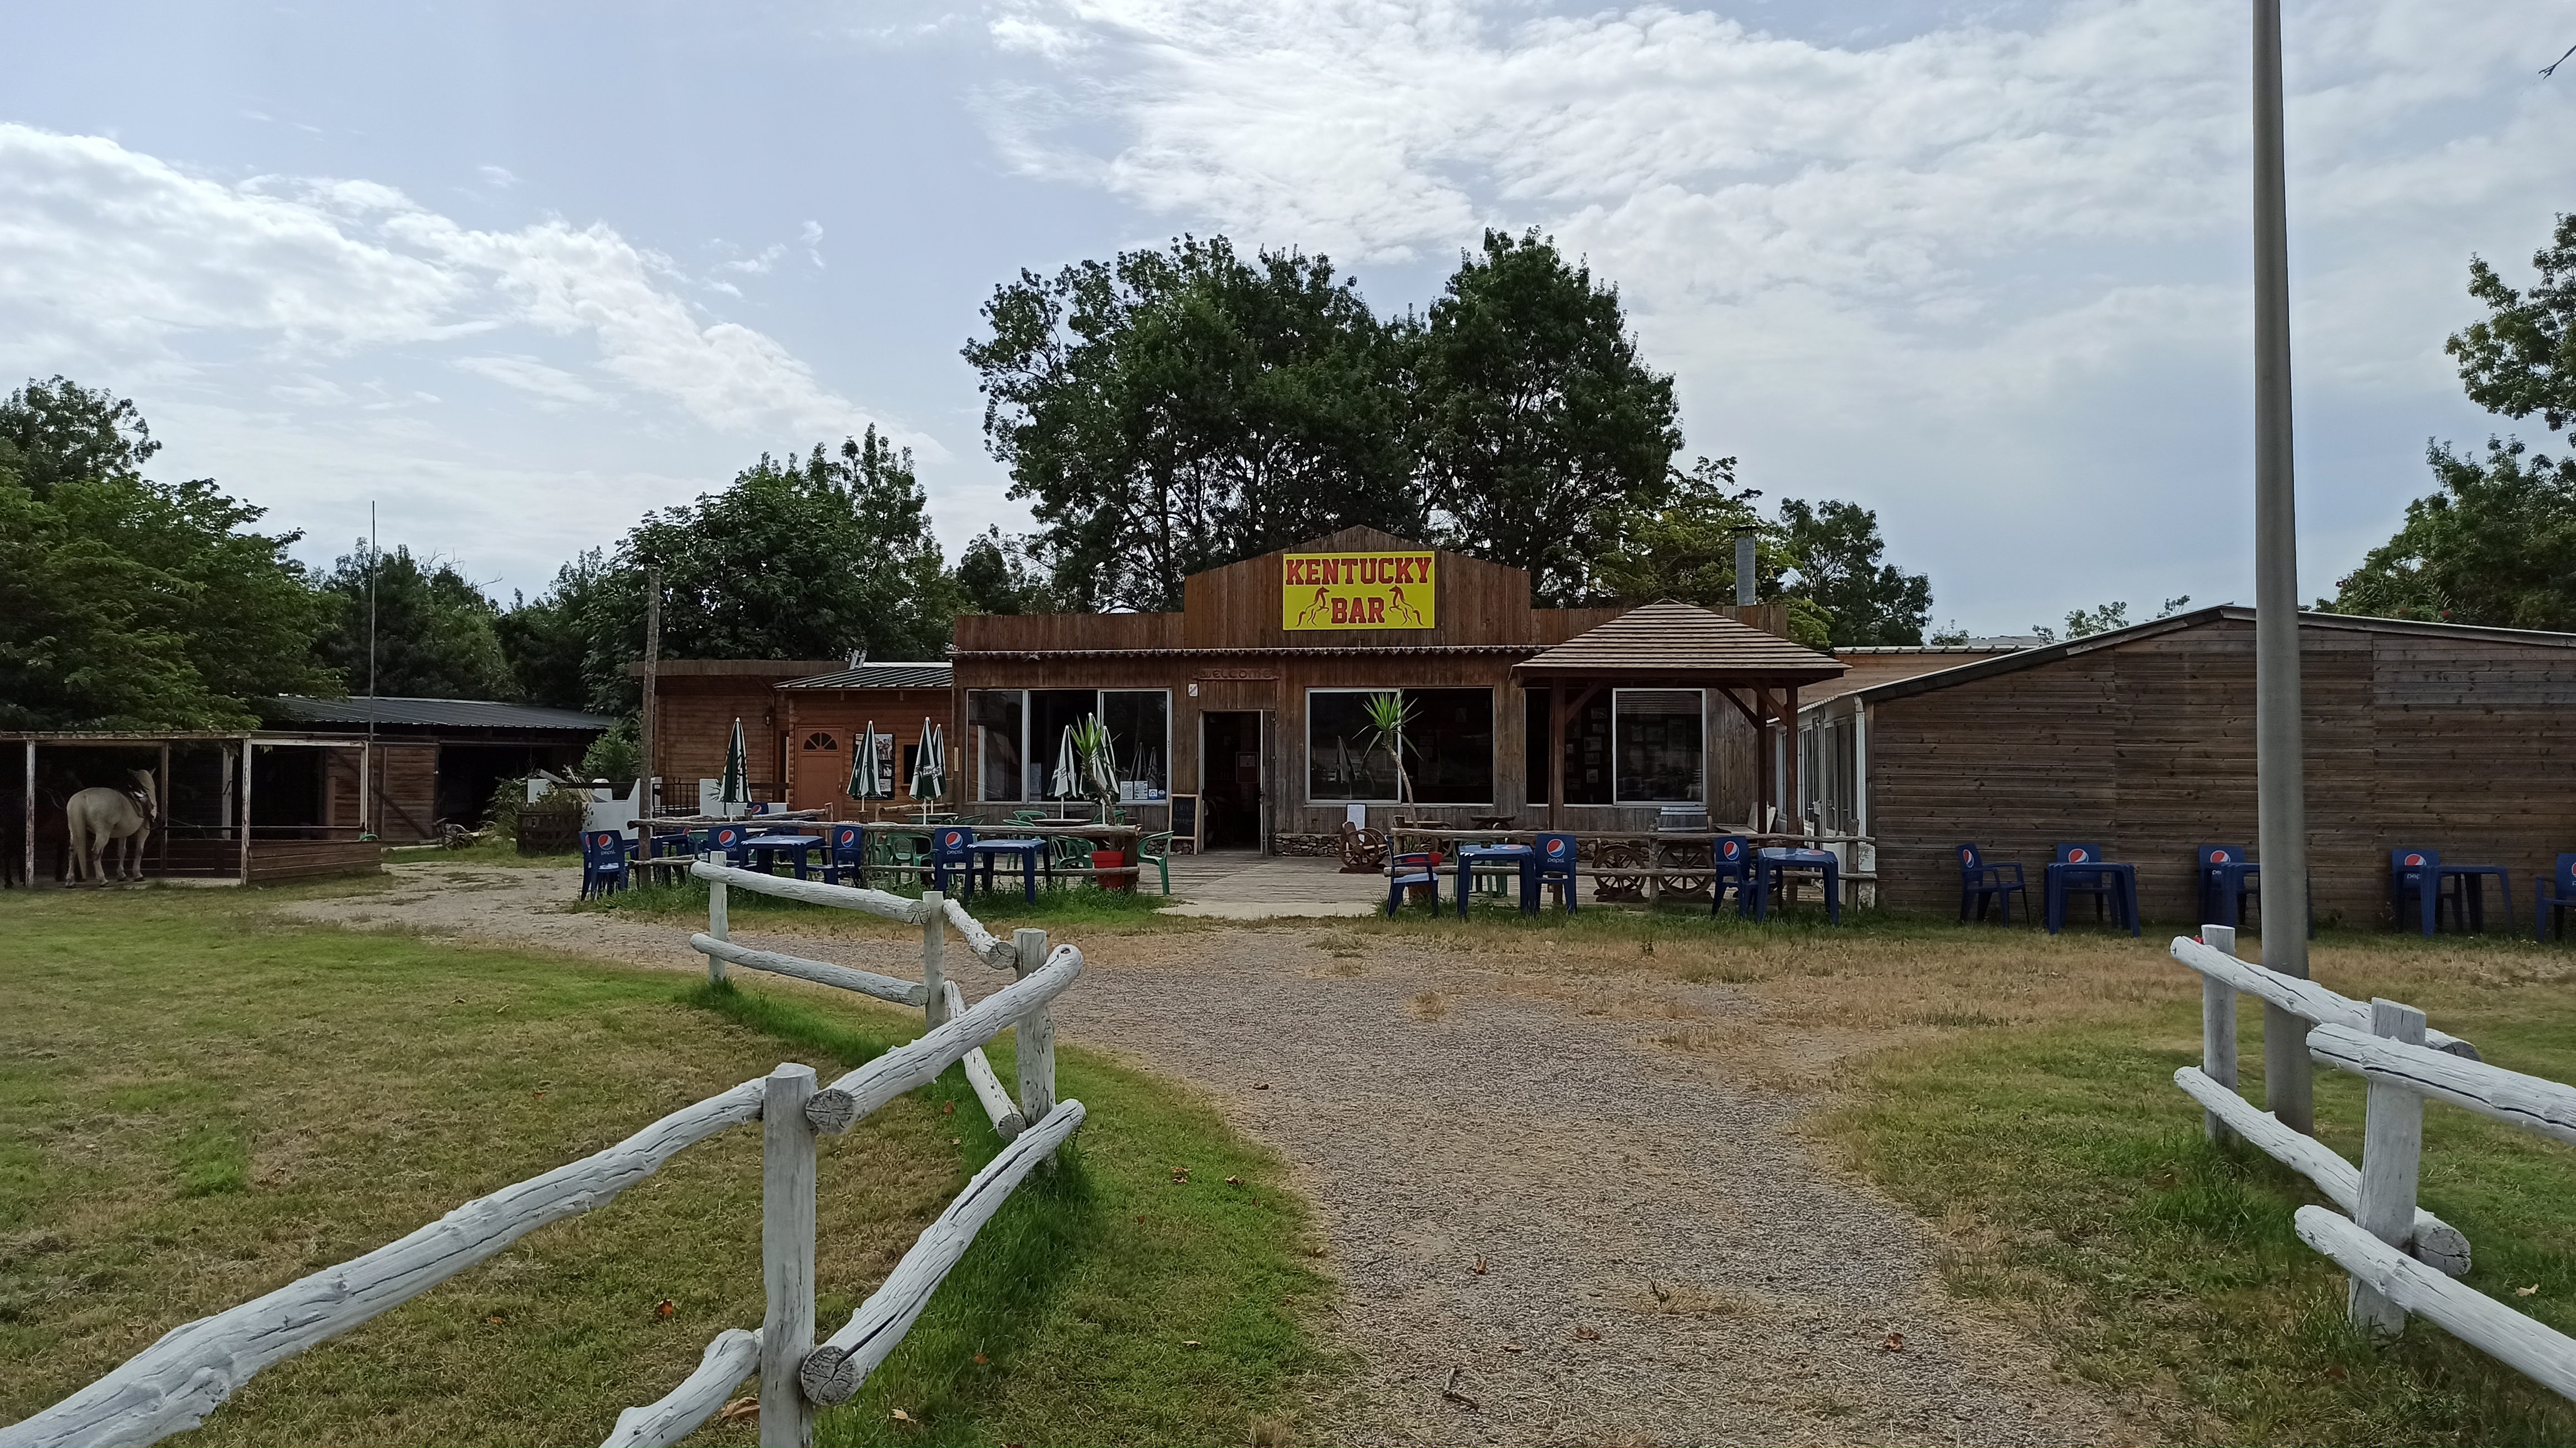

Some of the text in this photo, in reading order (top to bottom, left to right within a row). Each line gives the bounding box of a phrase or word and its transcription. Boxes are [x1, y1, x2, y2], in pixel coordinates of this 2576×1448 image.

[1286, 557, 1432, 585] KENTUCKY
[1331, 597, 1385, 624] BAR
[1199, 669, 1271, 678] WELCOME
